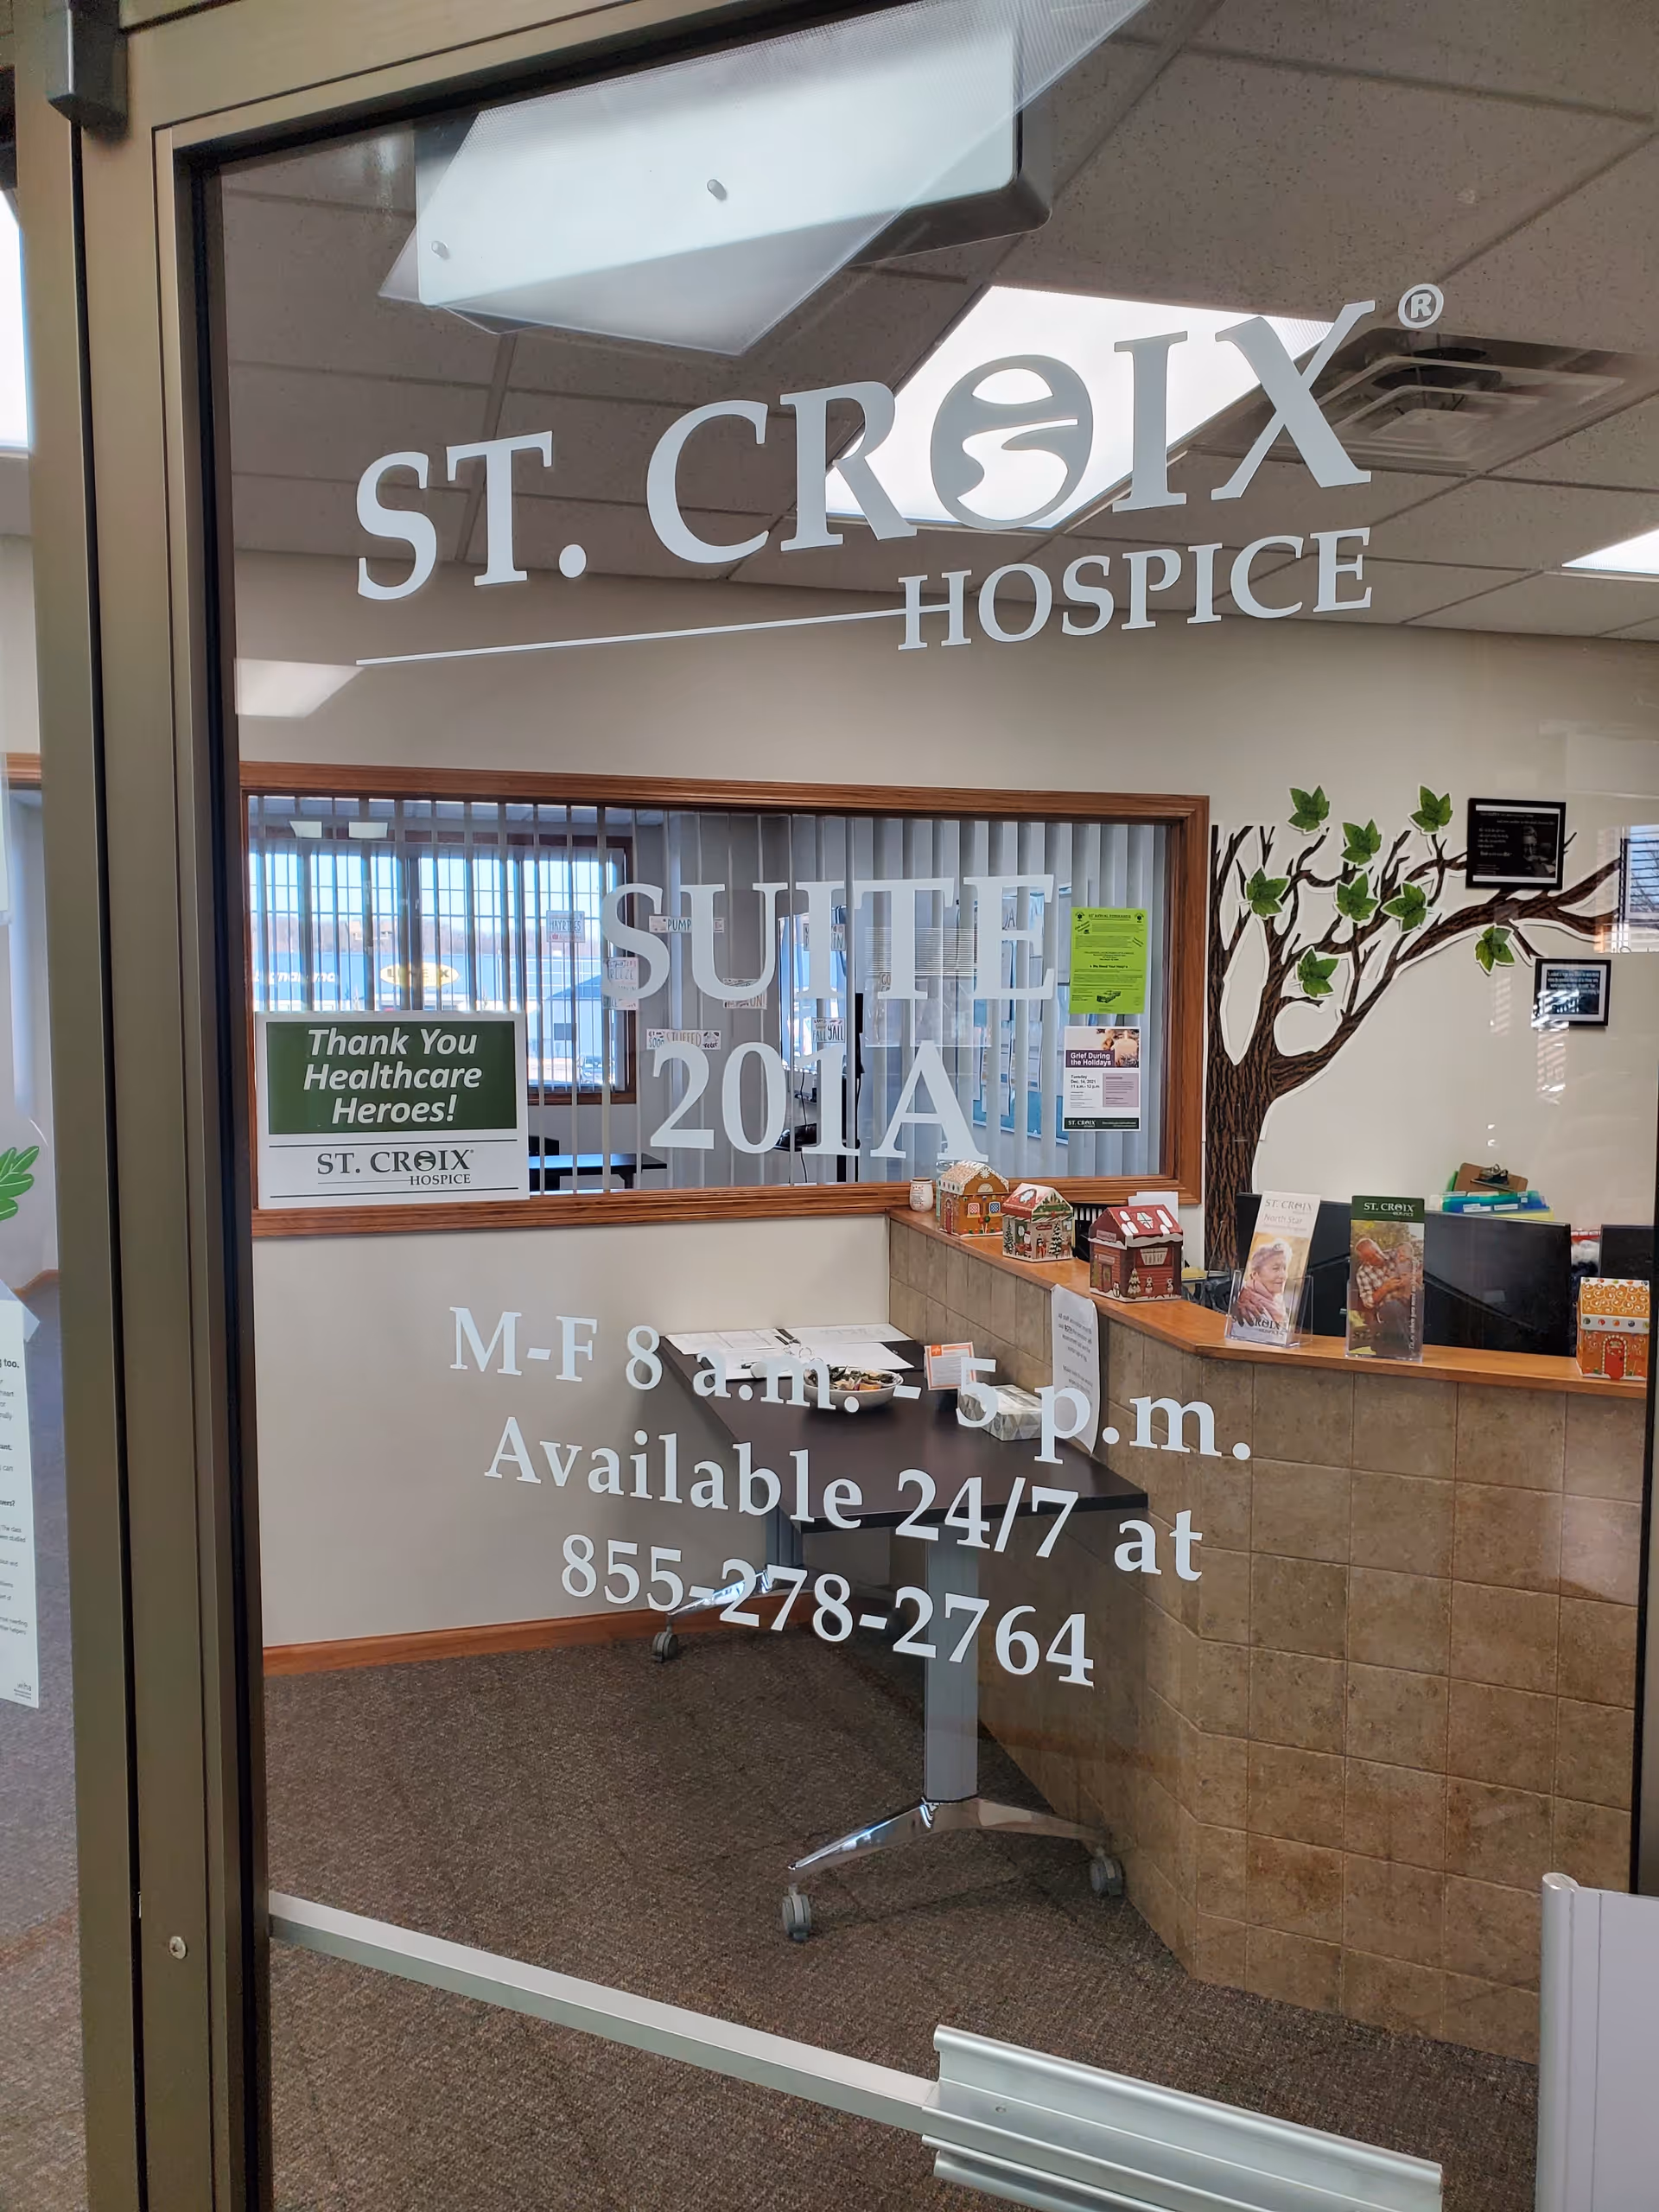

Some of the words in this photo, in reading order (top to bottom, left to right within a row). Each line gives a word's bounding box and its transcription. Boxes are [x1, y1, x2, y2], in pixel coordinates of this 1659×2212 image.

[356, 430, 587, 600] ST.
[898, 527, 1373, 651] HOSPICE
[601, 874, 1056, 1001] SUITE
[308, 1027, 410, 1056] Thank
[420, 1028, 478, 1055] You
[303, 1061, 482, 1090] Healthcare
[1083, 1058, 1112, 1067] Holidays
[332, 1094, 457, 1124] Heroes!
[650, 1039, 989, 1162] 201A
[317, 1153, 360, 1175] ST.
[410, 1173, 472, 1185] HOSPICE
[1265, 1198, 1278, 1208] ST.
[1363, 1202, 1379, 1211] ST.
[1381, 1203, 1415, 1212] CROIX
[4, 1358, 20, 1369] too.
[449, 1306, 598, 1382] M-F
[626, 1325, 663, 1390] 8
[692, 1350, 861, 1414] a.m.
[956, 1357, 998, 1428] 5
[1033, 1384, 1251, 1465] p.m.
[484, 1416, 863, 1529] Available
[895, 1468, 1079, 1558] 24/7
[1114, 1510, 1203, 1581] at
[562, 1534, 1095, 1688] 855-278-2764
